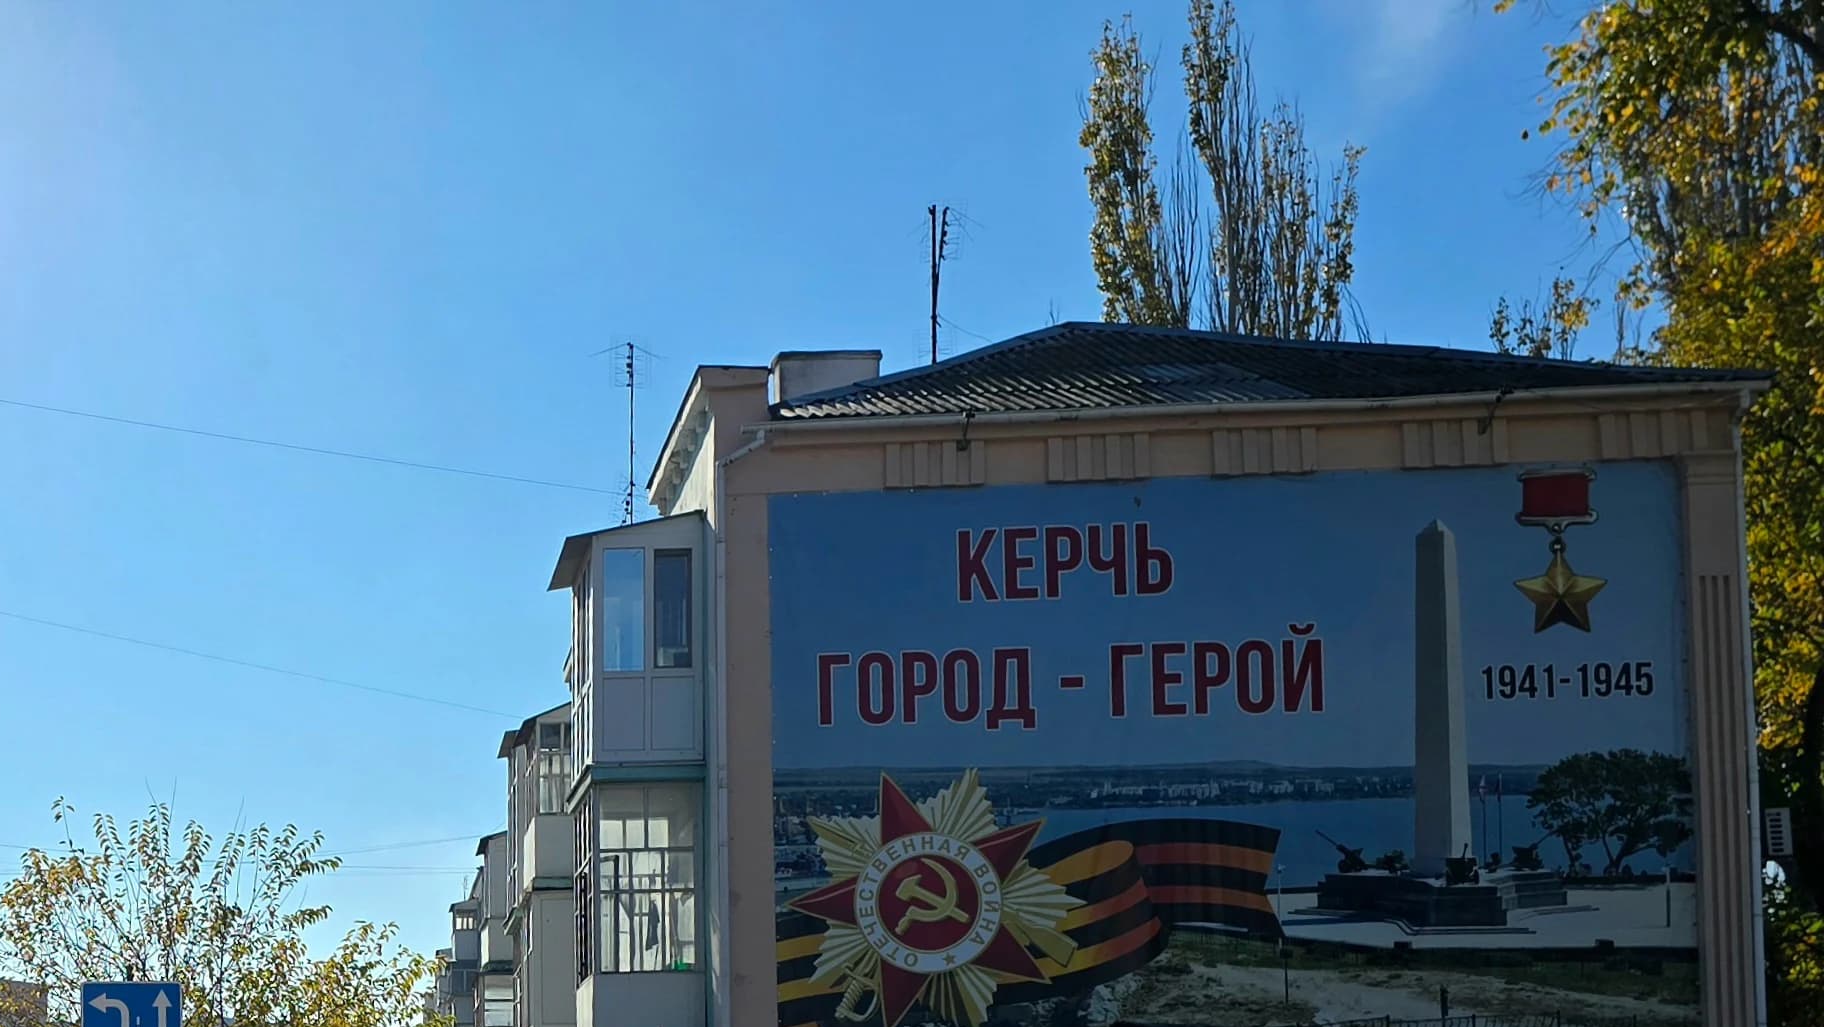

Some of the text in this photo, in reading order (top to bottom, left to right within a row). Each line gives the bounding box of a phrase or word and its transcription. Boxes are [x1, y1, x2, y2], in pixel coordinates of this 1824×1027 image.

[956, 521, 1174, 602] КЕРЧЬ
[816, 647, 1038, 731] ГОРОД
[1109, 622, 1326, 718] ГЕРОЙ
[1480, 660, 1655, 702] 1941-1945
[858, 835, 971, 968] ОТЕЧЕСТВЕННАЯ
